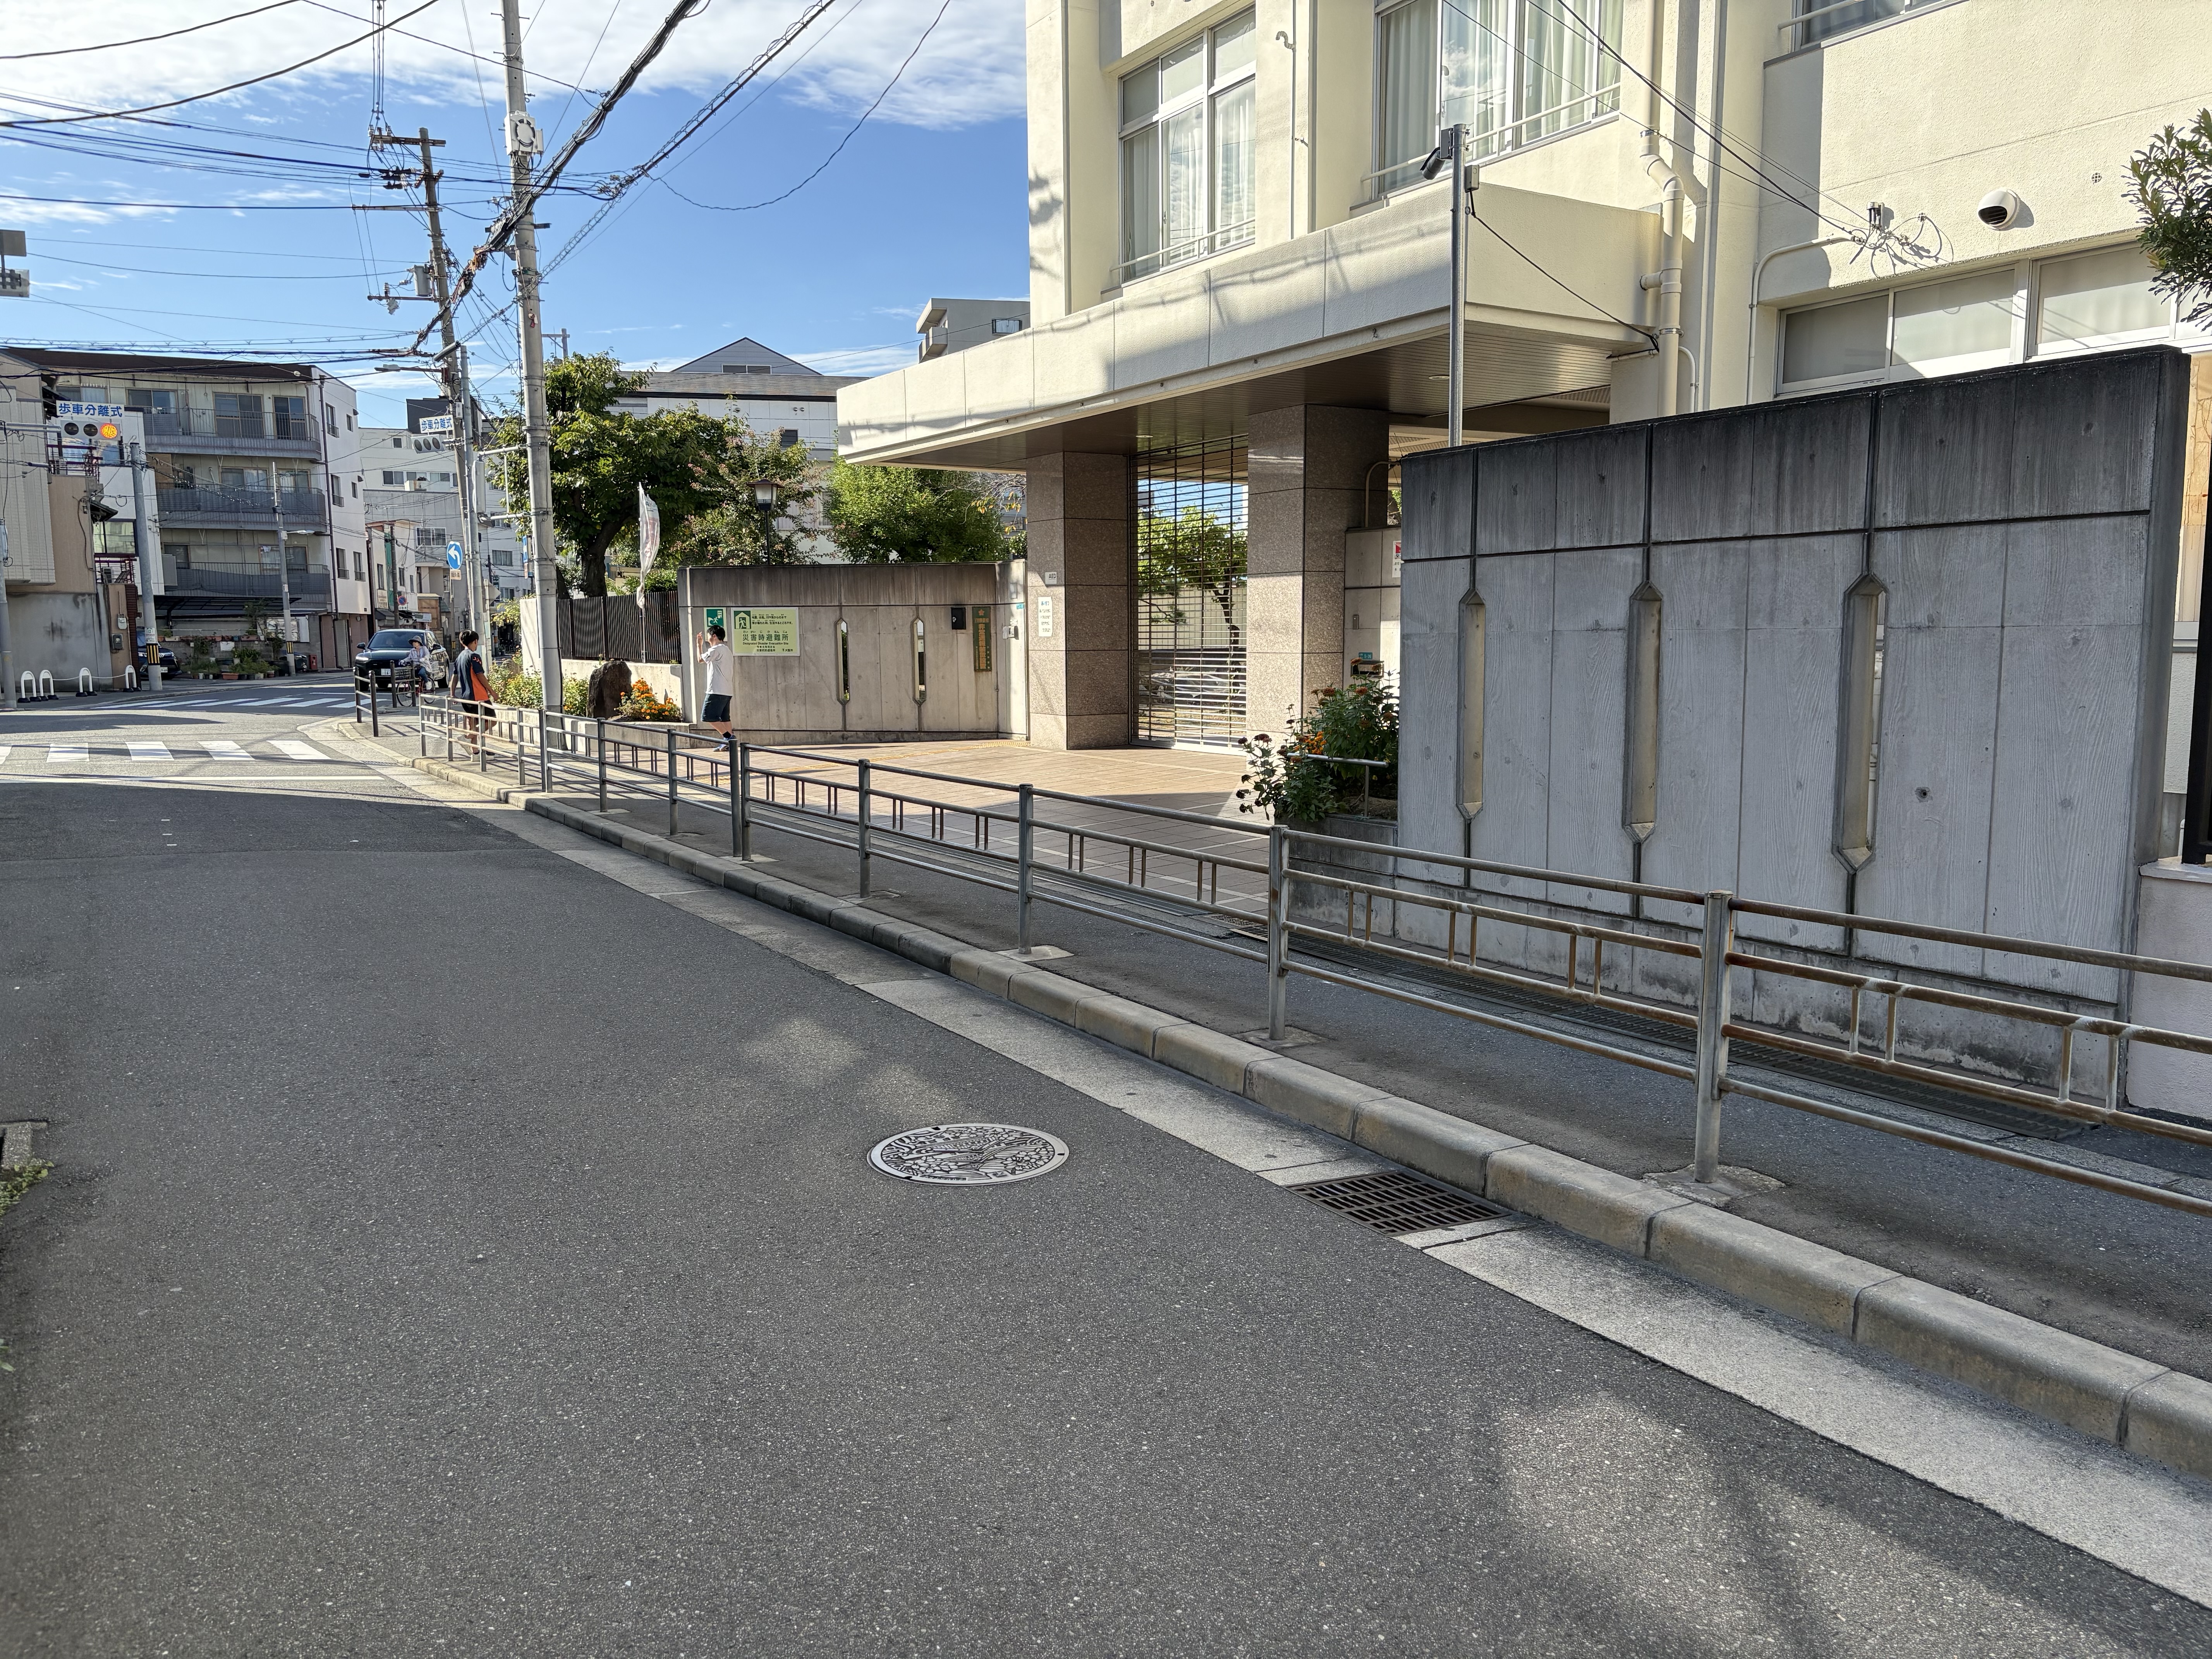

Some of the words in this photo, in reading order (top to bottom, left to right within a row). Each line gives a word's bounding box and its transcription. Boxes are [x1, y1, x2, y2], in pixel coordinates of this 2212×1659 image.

[59, 403, 122, 417] 歩車分離式
[421, 417, 452, 431] 歩車分離式
